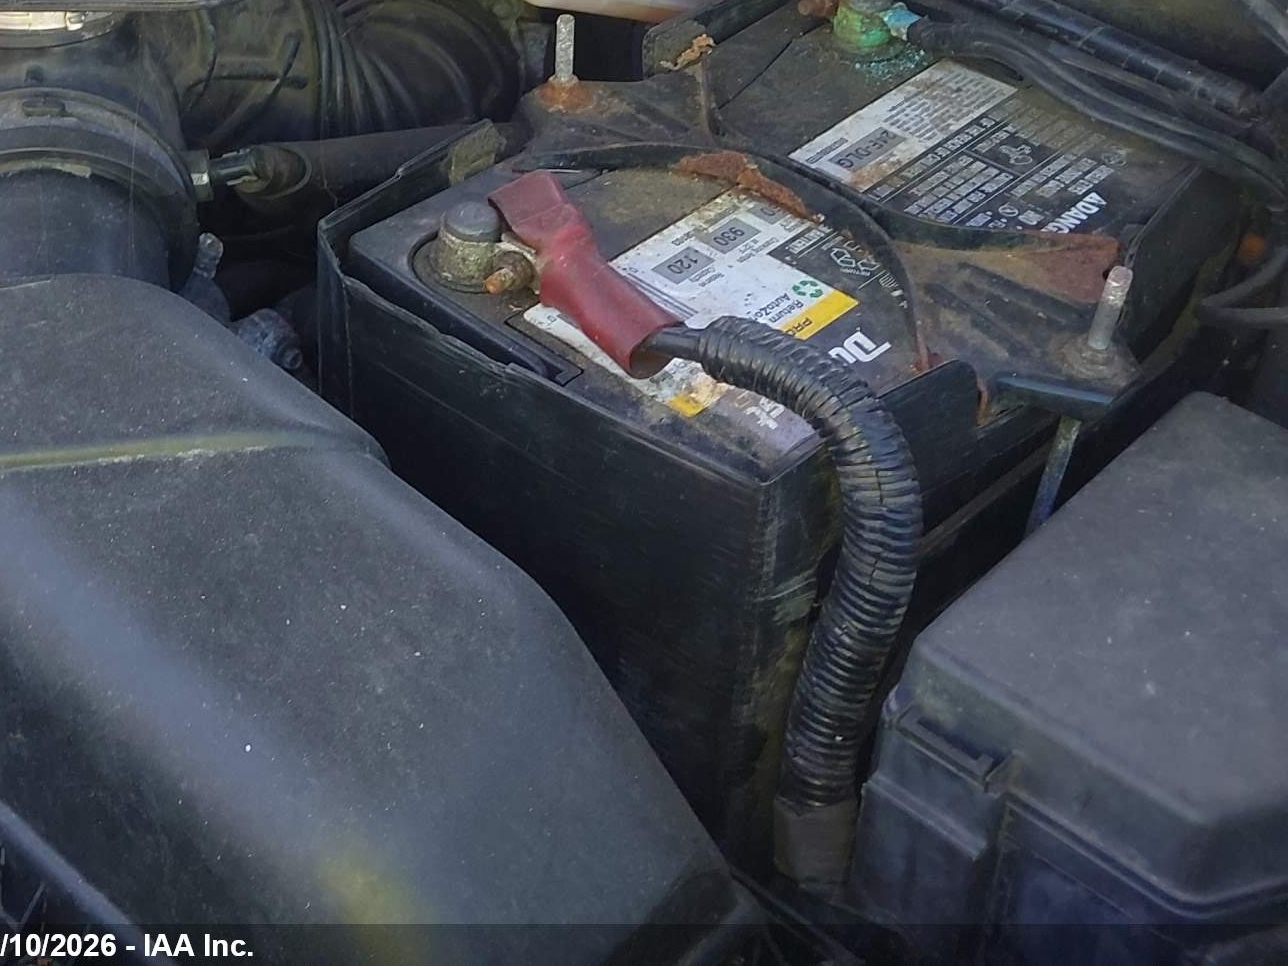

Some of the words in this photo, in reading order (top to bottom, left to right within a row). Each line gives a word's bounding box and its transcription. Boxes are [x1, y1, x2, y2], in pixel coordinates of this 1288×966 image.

[832, 129, 899, 168] 24F-DLG
[1040, 200, 1100, 239] DANG
[710, 226, 747, 247] 930
[664, 253, 701, 275] 120
[766, 299, 805, 324] Return
